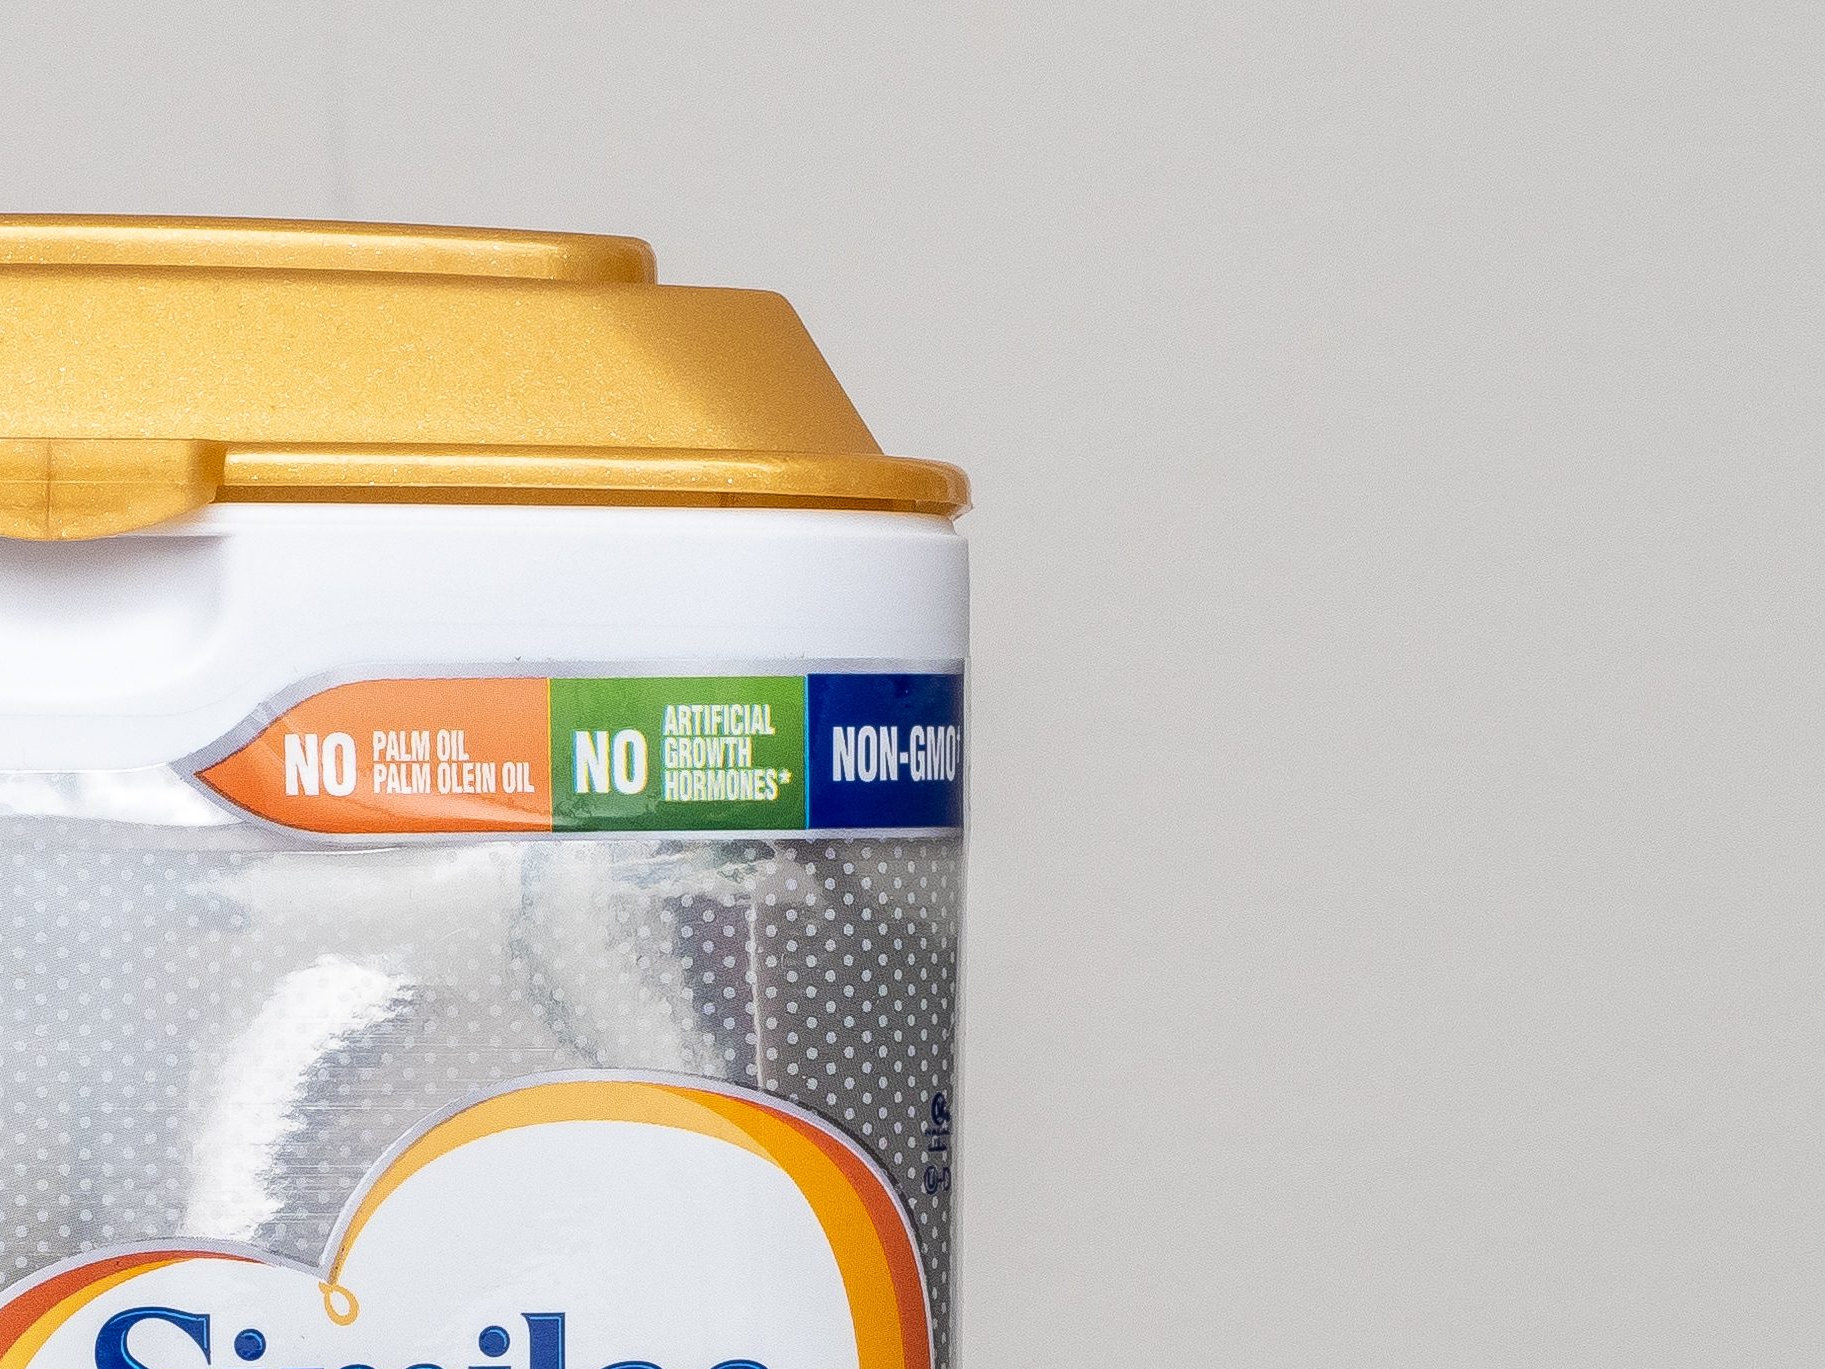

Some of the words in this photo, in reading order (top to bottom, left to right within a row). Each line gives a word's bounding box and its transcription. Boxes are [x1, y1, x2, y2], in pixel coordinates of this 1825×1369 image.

[663, 704, 775, 736] ARTIFICIAL
[373, 730, 430, 761] PALM
[437, 730, 470, 760] OIL
[663, 736, 752, 768] GROWTH
[284, 732, 356, 797] NO
[373, 763, 433, 793] PALM
[438, 763, 500, 793] OLEIN
[502, 762, 535, 793] OIL
[574, 729, 647, 795] NO
